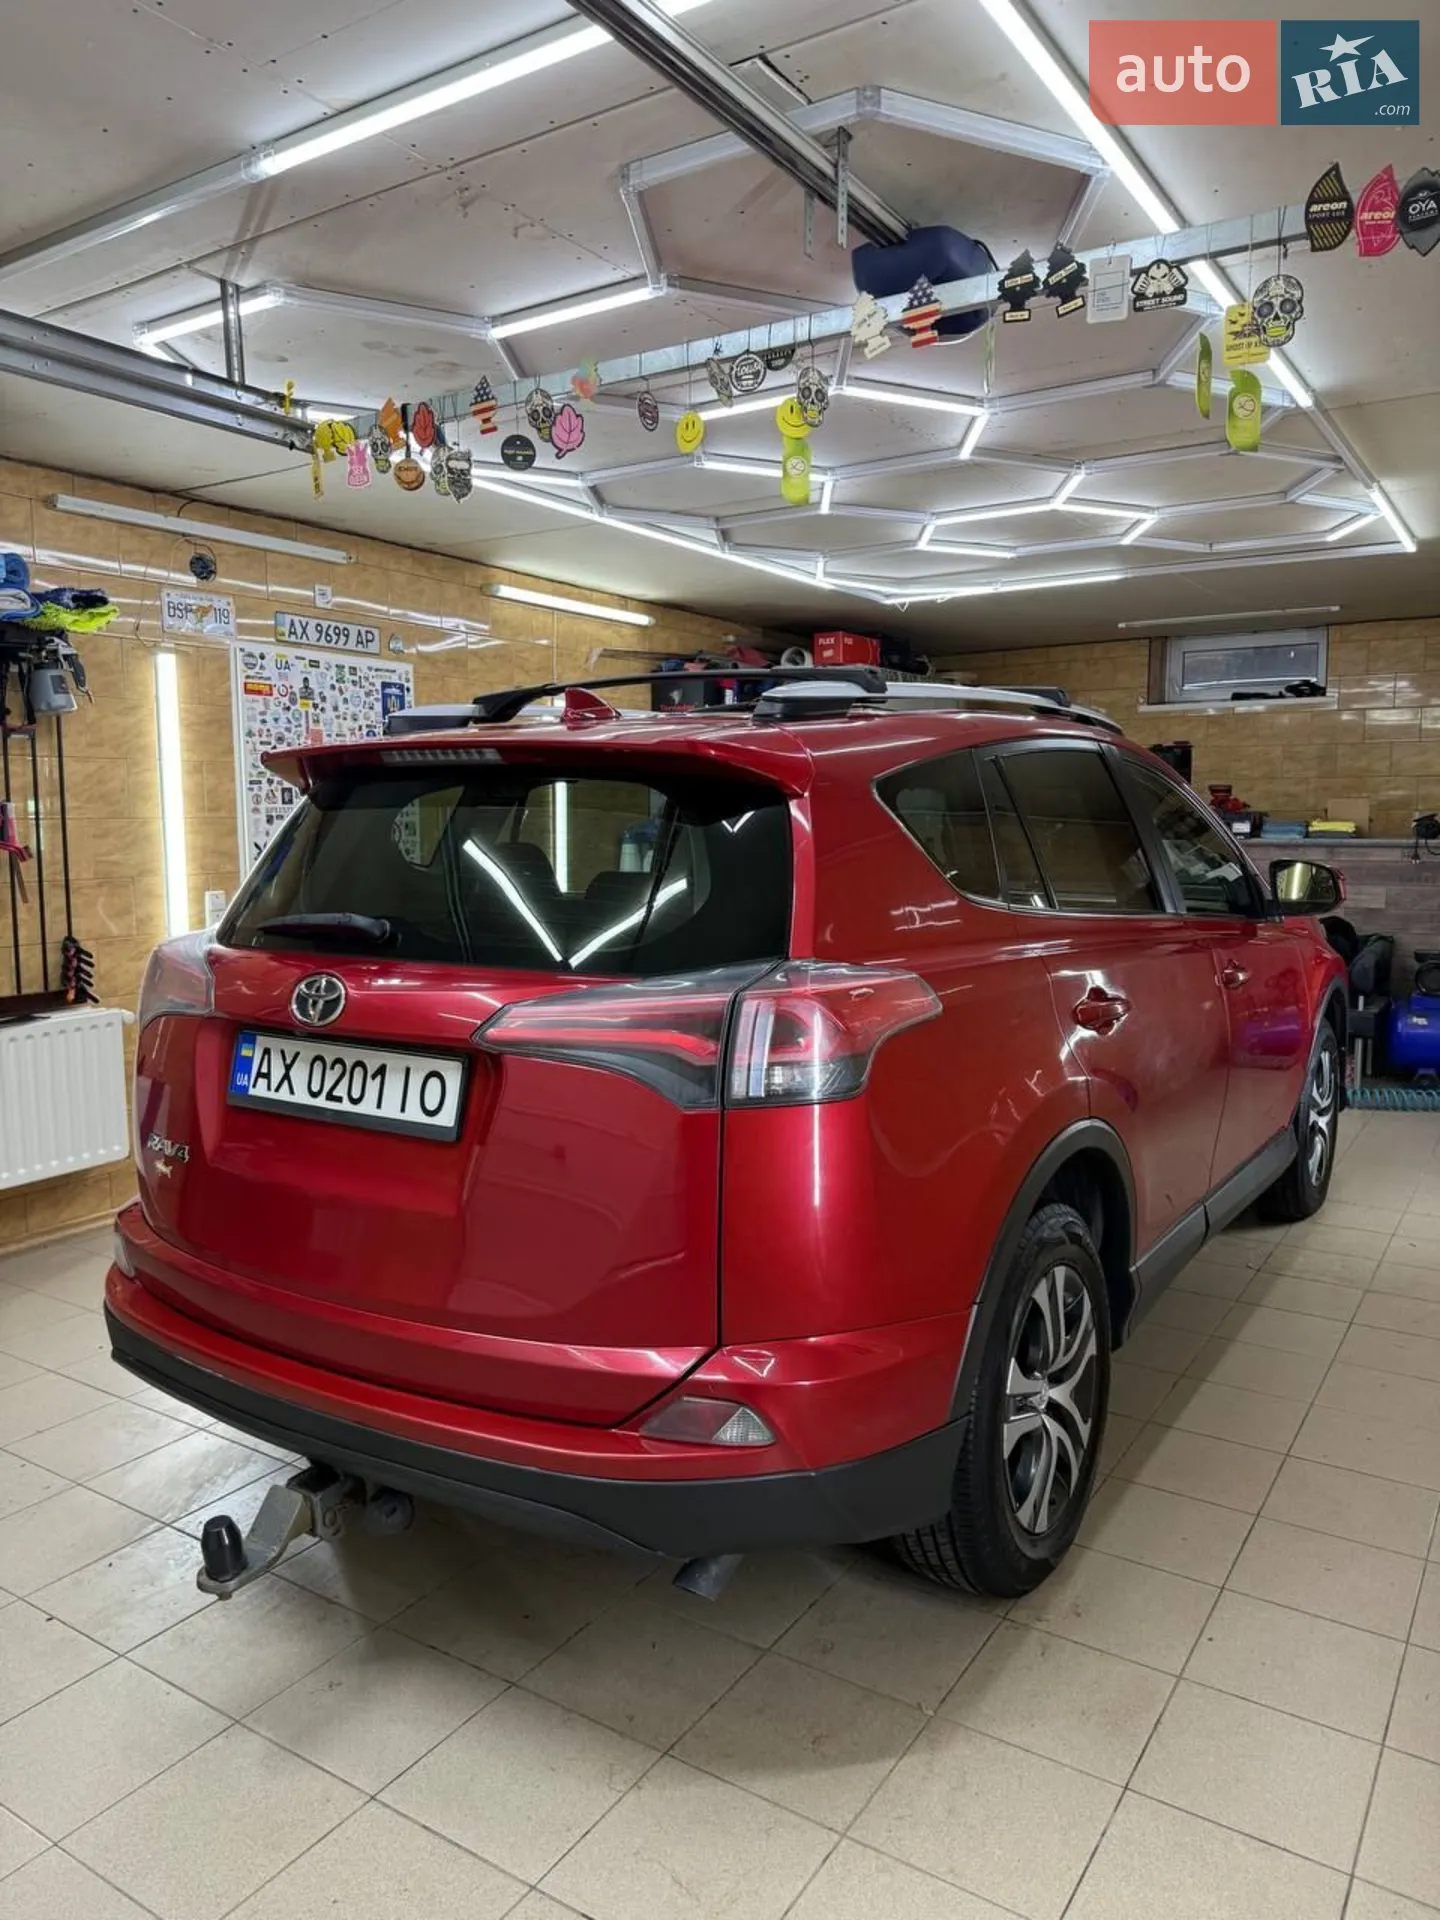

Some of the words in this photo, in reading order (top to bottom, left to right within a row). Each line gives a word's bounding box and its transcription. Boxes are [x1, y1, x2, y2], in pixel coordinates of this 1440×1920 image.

[1309, 201, 1347, 213] areon
[1408, 199, 1438, 214] OYA
[287, 618, 311, 642] AX
[315, 623, 350, 646] 9699
[354, 631, 375, 649] AP
[236, 1072, 249, 1087] UA
[252, 1047, 300, 1096] AX
[307, 1054, 388, 1110] 0201
[400, 1066, 447, 1117] IO
[148, 1133, 190, 1163] RAV4
